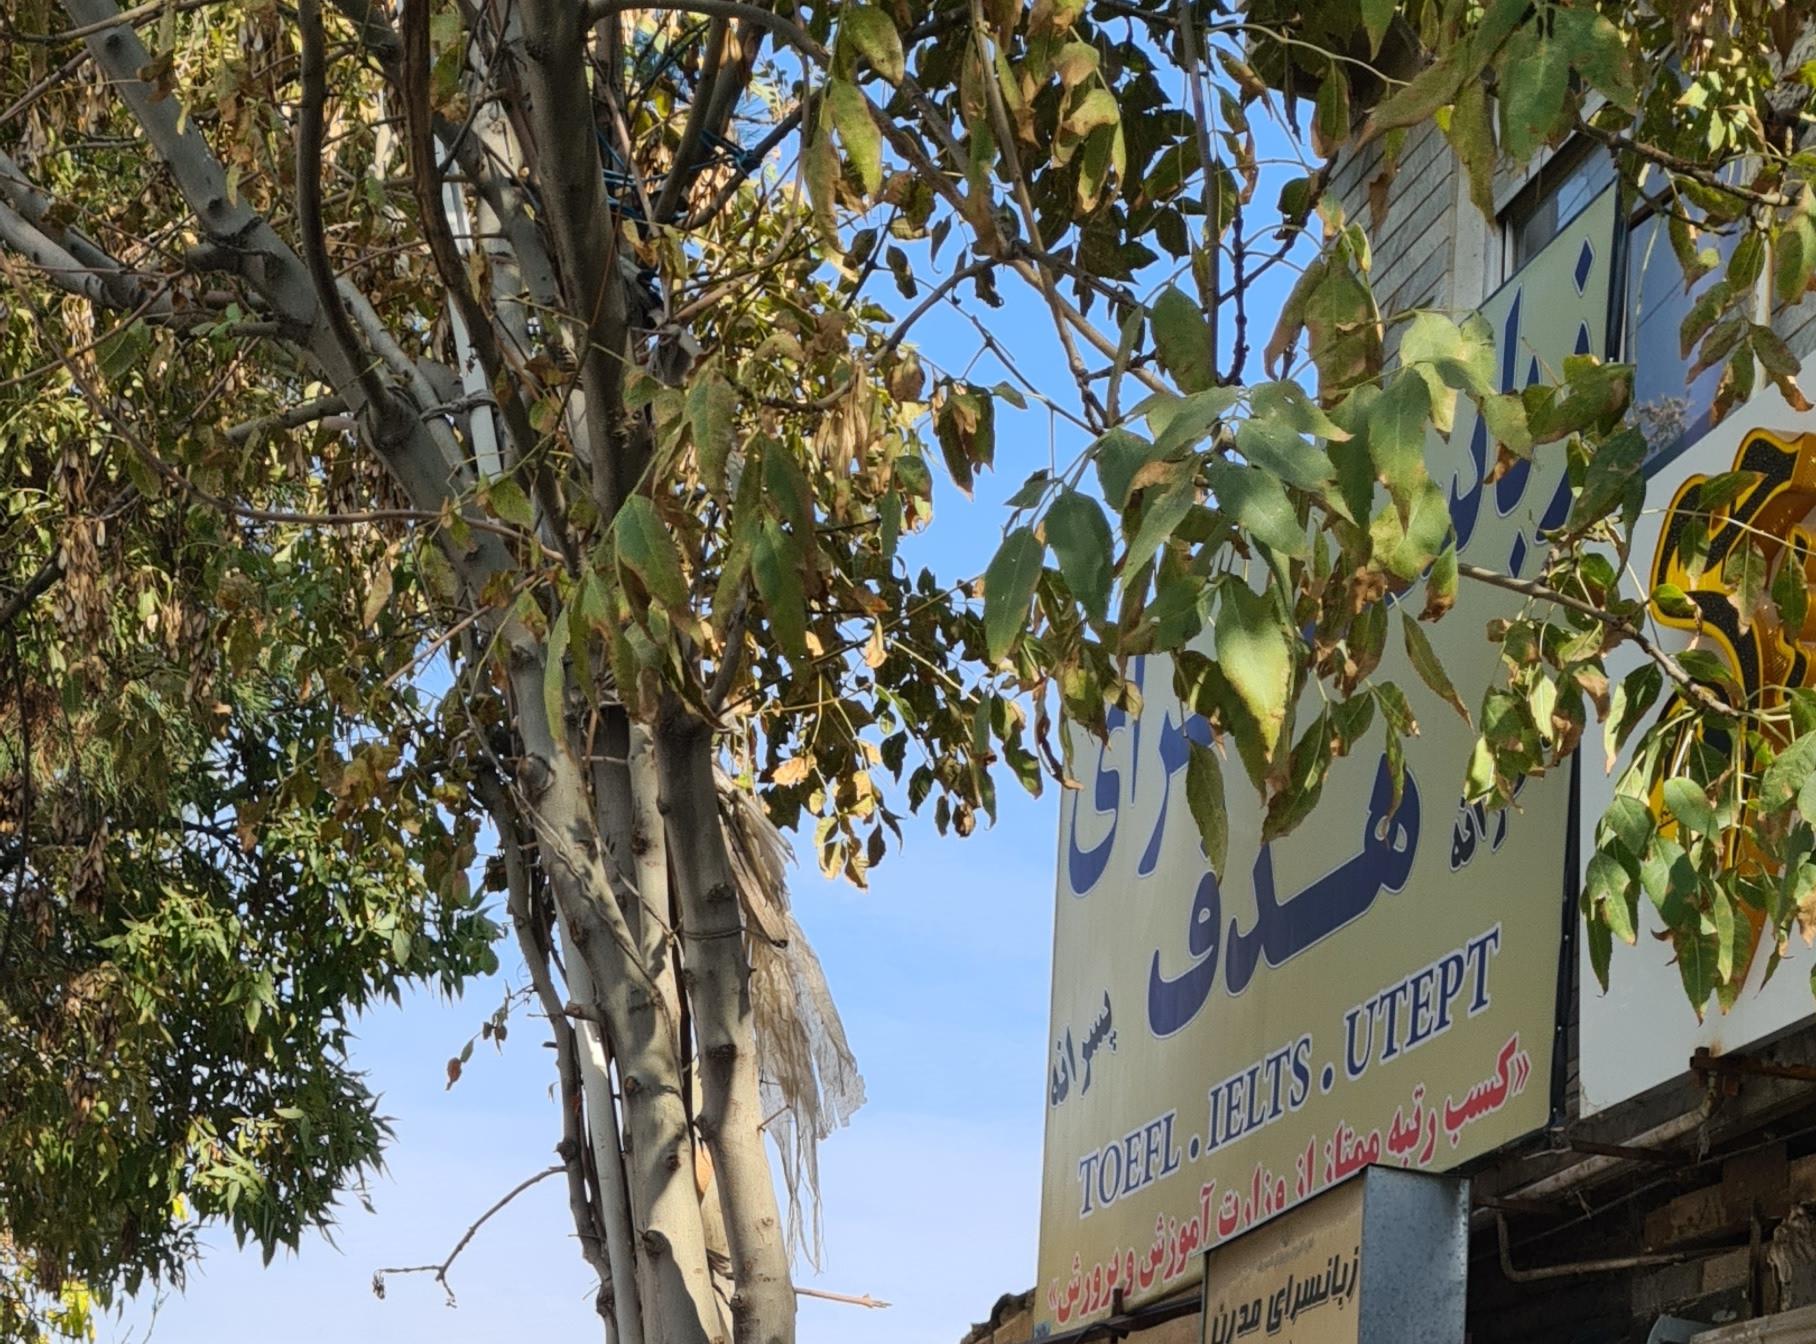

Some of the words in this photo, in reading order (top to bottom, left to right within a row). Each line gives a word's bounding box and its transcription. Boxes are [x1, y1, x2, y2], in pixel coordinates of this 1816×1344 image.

[1147, 753, 1420, 1039] هدف
[1078, 1110, 1181, 1217] TOEFL
[1206, 1035, 1312, 1152] IELTS
[1344, 925, 1501, 1077] UTEPT
[1387, 1085, 1437, 1168] رتبه
[1266, 1246, 1360, 1334] زبانسرای
